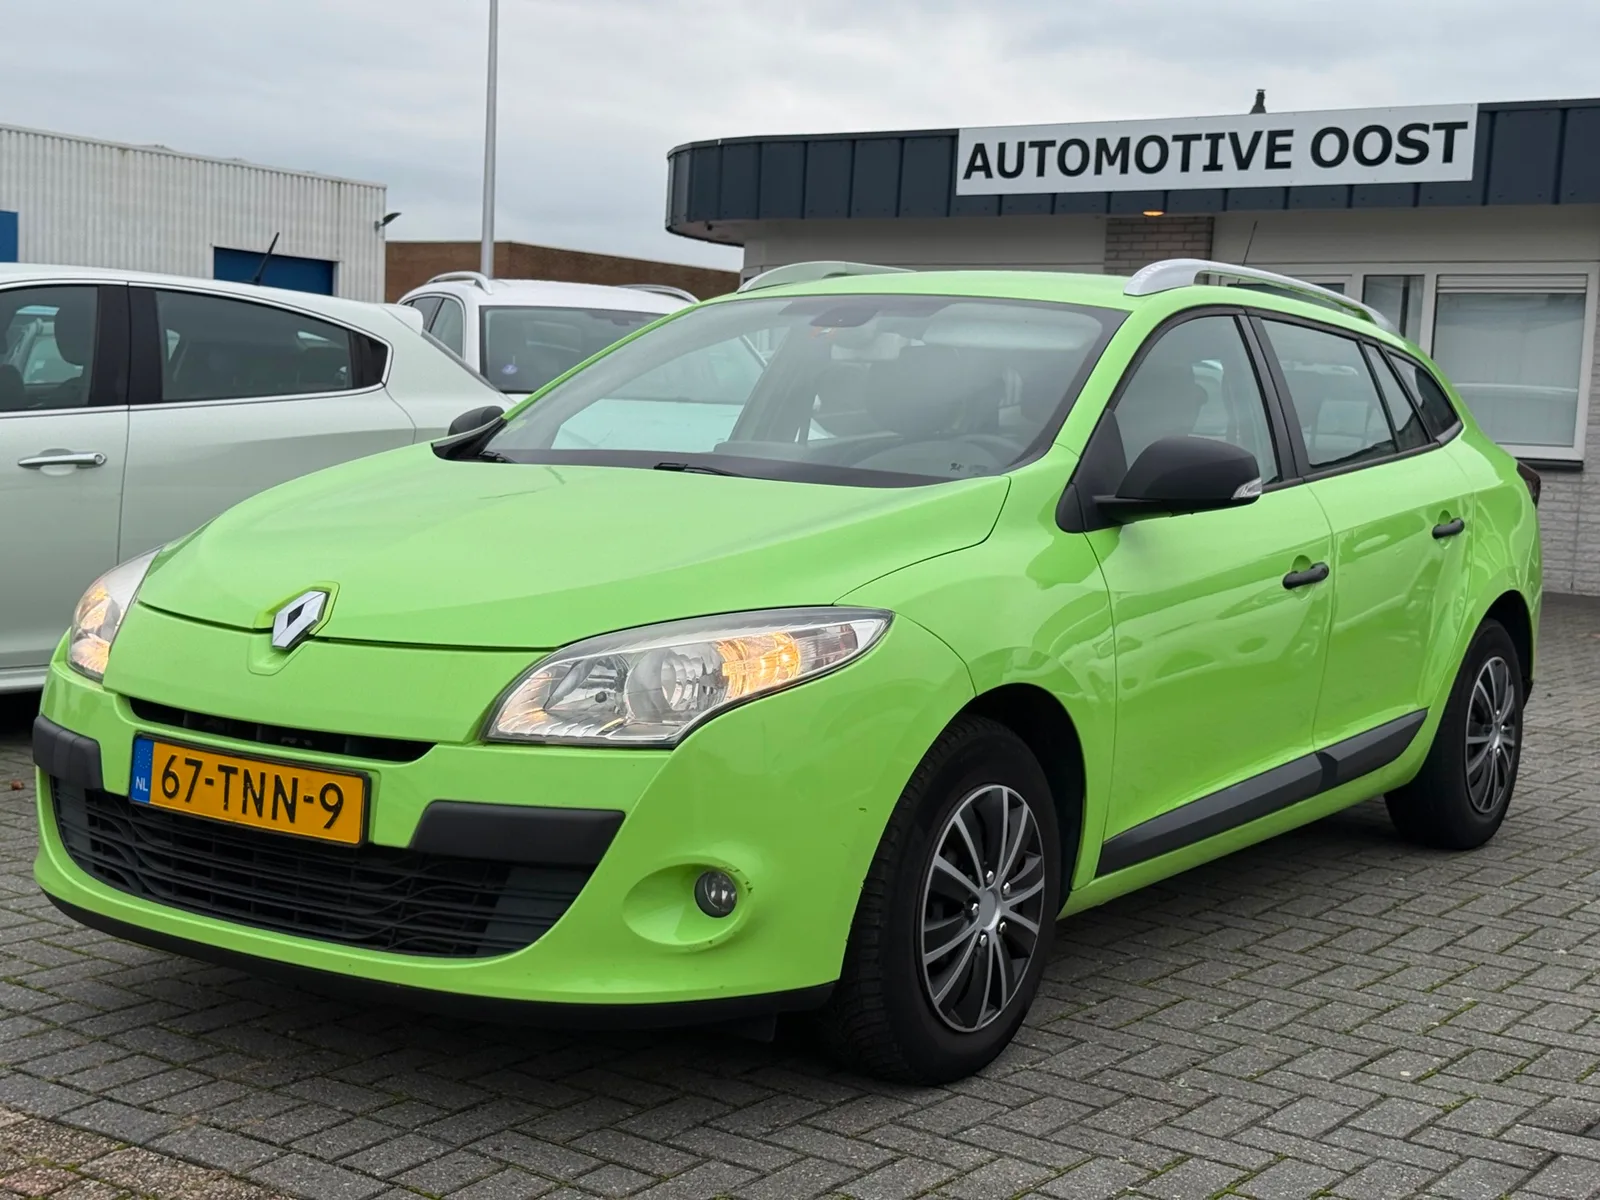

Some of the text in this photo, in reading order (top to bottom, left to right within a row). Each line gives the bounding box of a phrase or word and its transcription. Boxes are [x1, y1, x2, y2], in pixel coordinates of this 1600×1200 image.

[963, 121, 1468, 180] AUTOMOTIVE OOST
[135, 776, 148, 792] NL
[161, 755, 344, 829] 67-TNN-9
